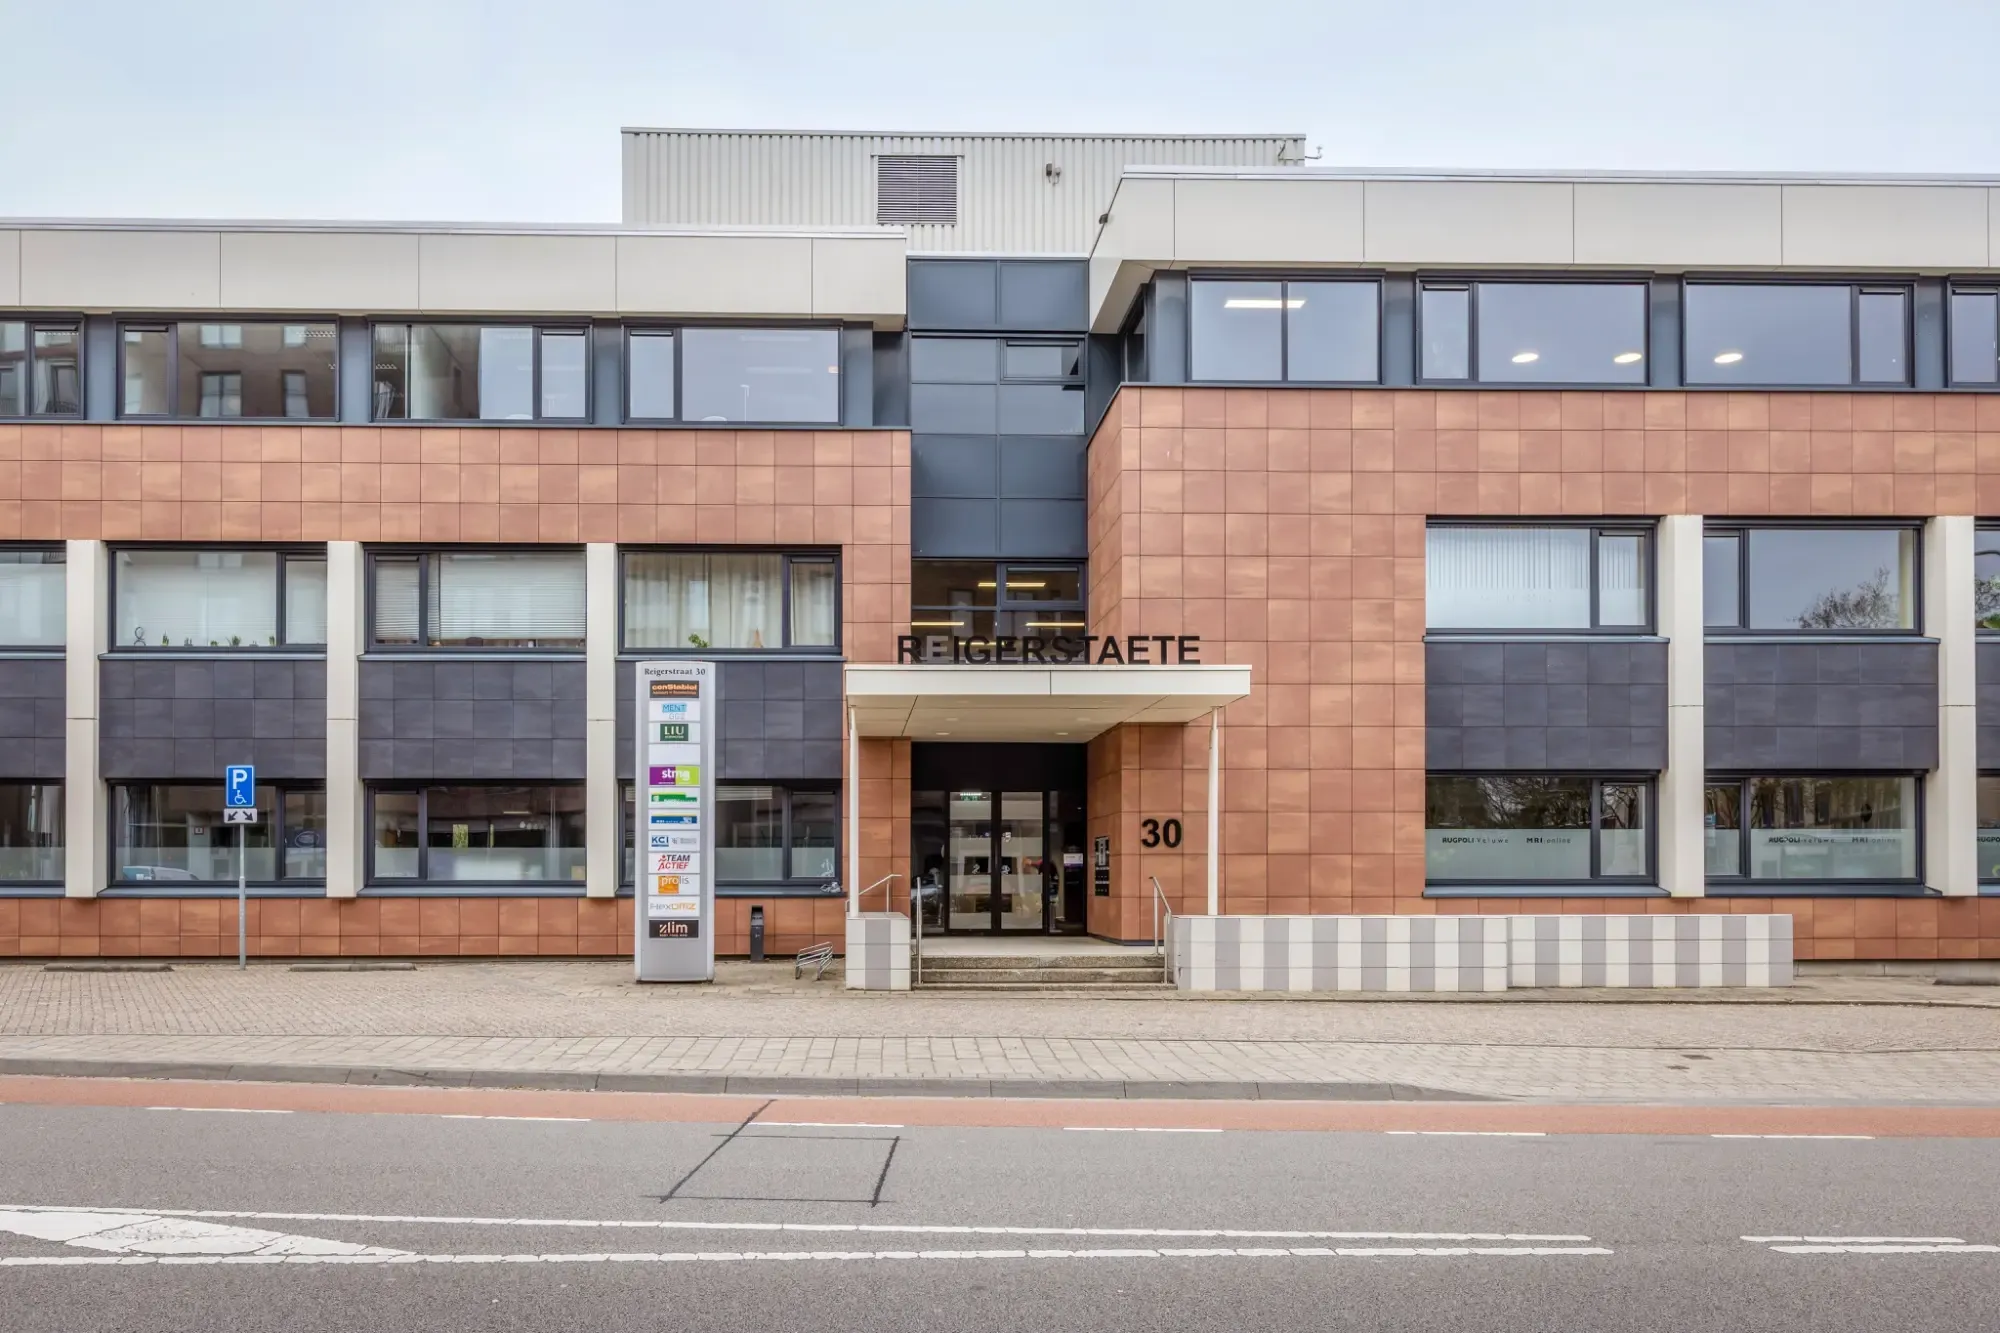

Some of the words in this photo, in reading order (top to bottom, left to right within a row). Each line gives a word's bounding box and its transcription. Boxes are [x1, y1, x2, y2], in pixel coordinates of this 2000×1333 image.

[897, 635, 1200, 665] REIGERSTAETE
[644, 668, 693, 676] Reigerstraat
[662, 704, 687, 712] MENT
[664, 726, 684, 735] LIU
[232, 769, 248, 789] P
[1141, 818, 1182, 848] 30
[651, 836, 669, 844] KCI
[658, 862, 689, 870] ACTIEF
[661, 876, 690, 887] prolis
